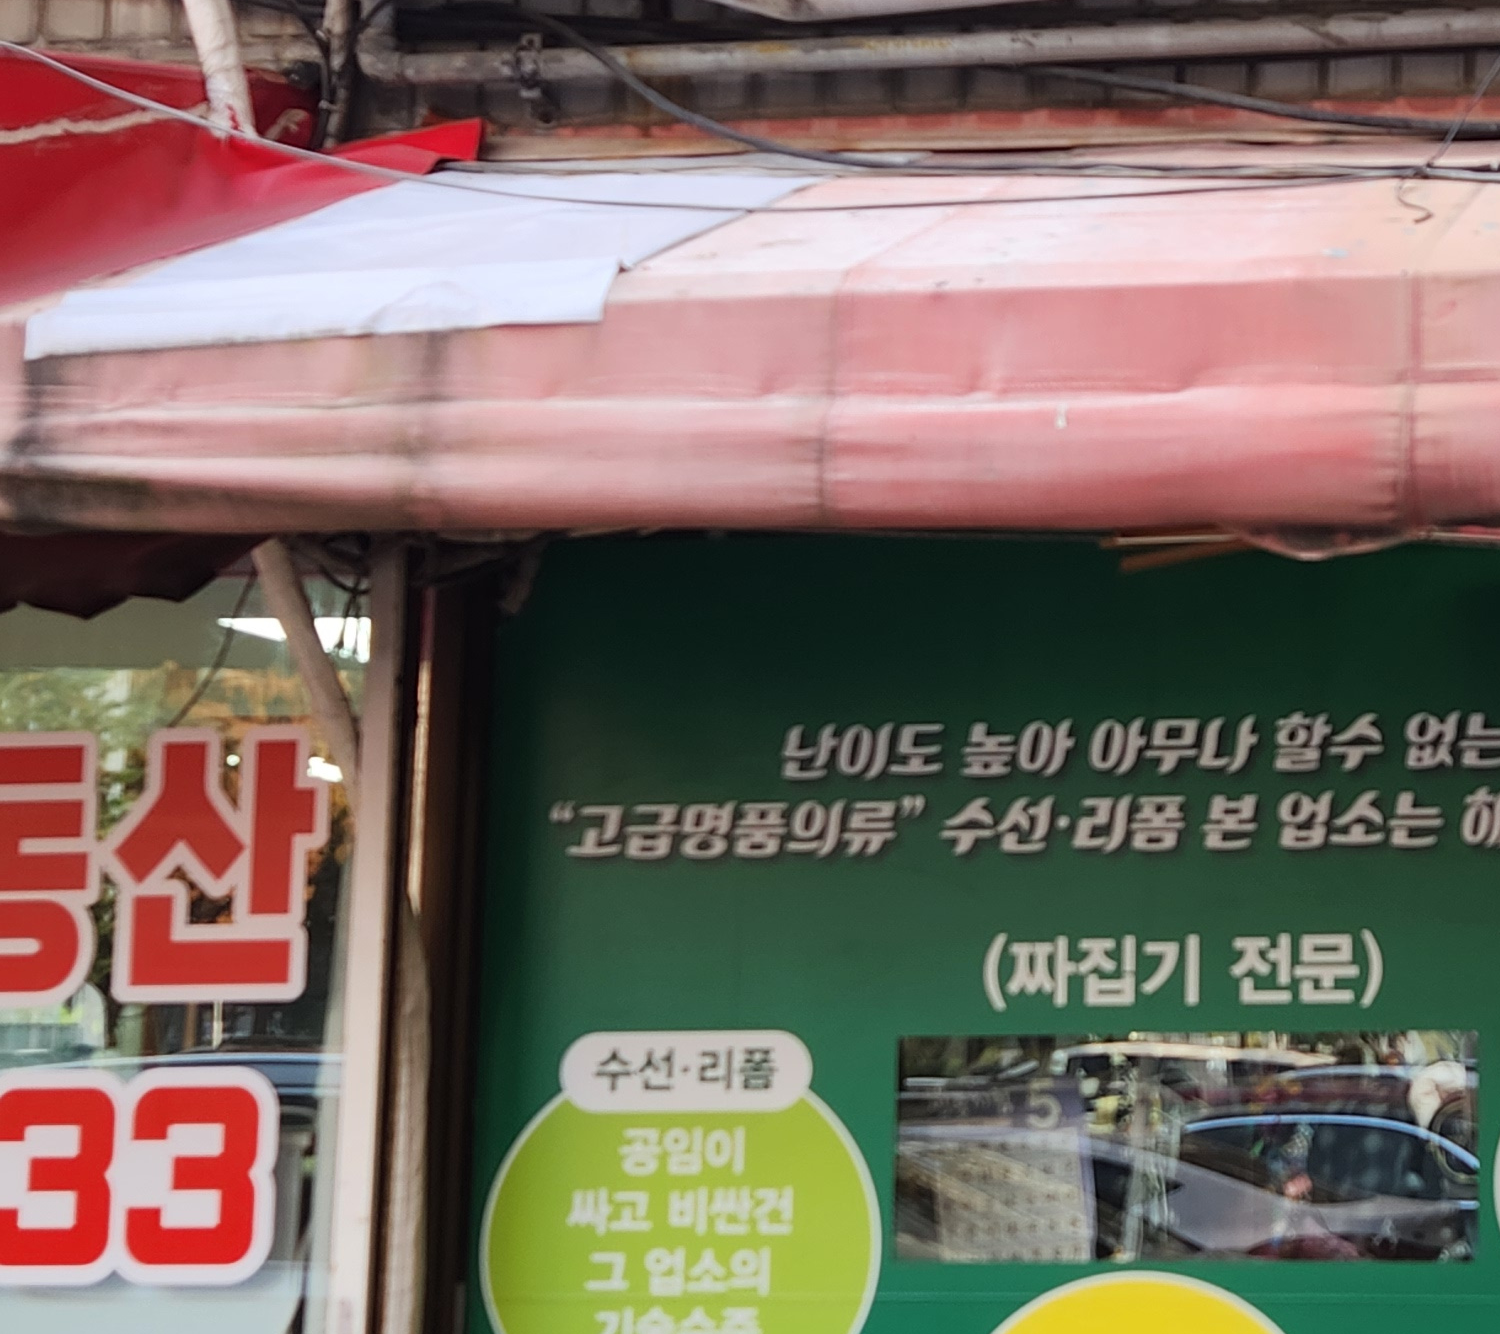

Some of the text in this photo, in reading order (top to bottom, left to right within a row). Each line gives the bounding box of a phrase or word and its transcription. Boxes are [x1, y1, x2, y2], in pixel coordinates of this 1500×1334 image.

[781, 721, 946, 781] 난이도
[960, 718, 1076, 777] 높아
[1087, 713, 1260, 775] 아무나
[1200, 793, 1260, 852] 본
[1276, 788, 1445, 850] 업소는
[982, 928, 1385, 1011] (짜집기 전문)
[618, 1126, 746, 1176] 공임이
[566, 1185, 795, 1237] 싸고 비싼건
[583, 1247, 772, 1298] 그 업소의
